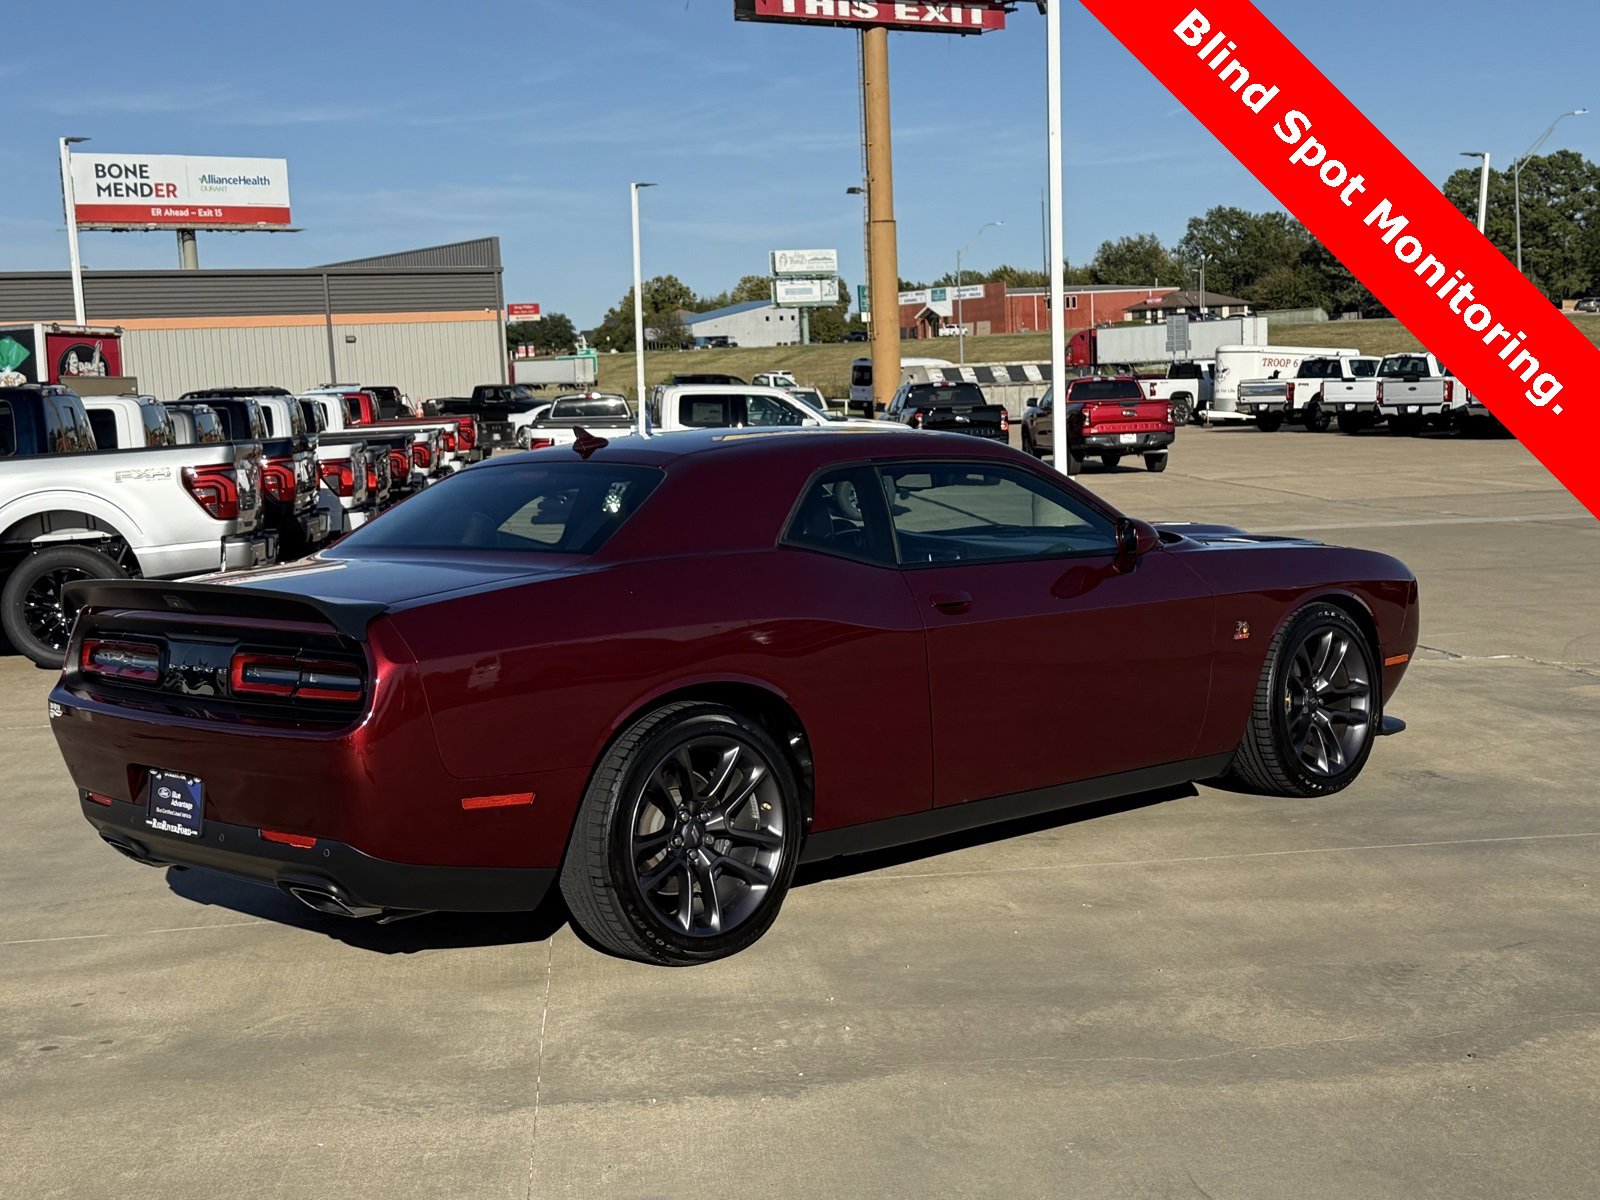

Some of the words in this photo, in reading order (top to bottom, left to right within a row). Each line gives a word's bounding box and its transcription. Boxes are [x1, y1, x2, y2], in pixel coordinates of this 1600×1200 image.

[894, 2, 988, 24] EXIT
[94, 163, 150, 179] BONE
[200, 174, 271, 186] AllianceHealth
[96, 182, 178, 198] MENDER
[151, 207, 163, 217] ER
[164, 207, 190, 217] Ahead
[198, 208, 214, 217] Exit
[214, 208, 223, 218] 15
[1262, 357, 1292, 367] TROOP
[1293, 359, 1299, 368] 6
